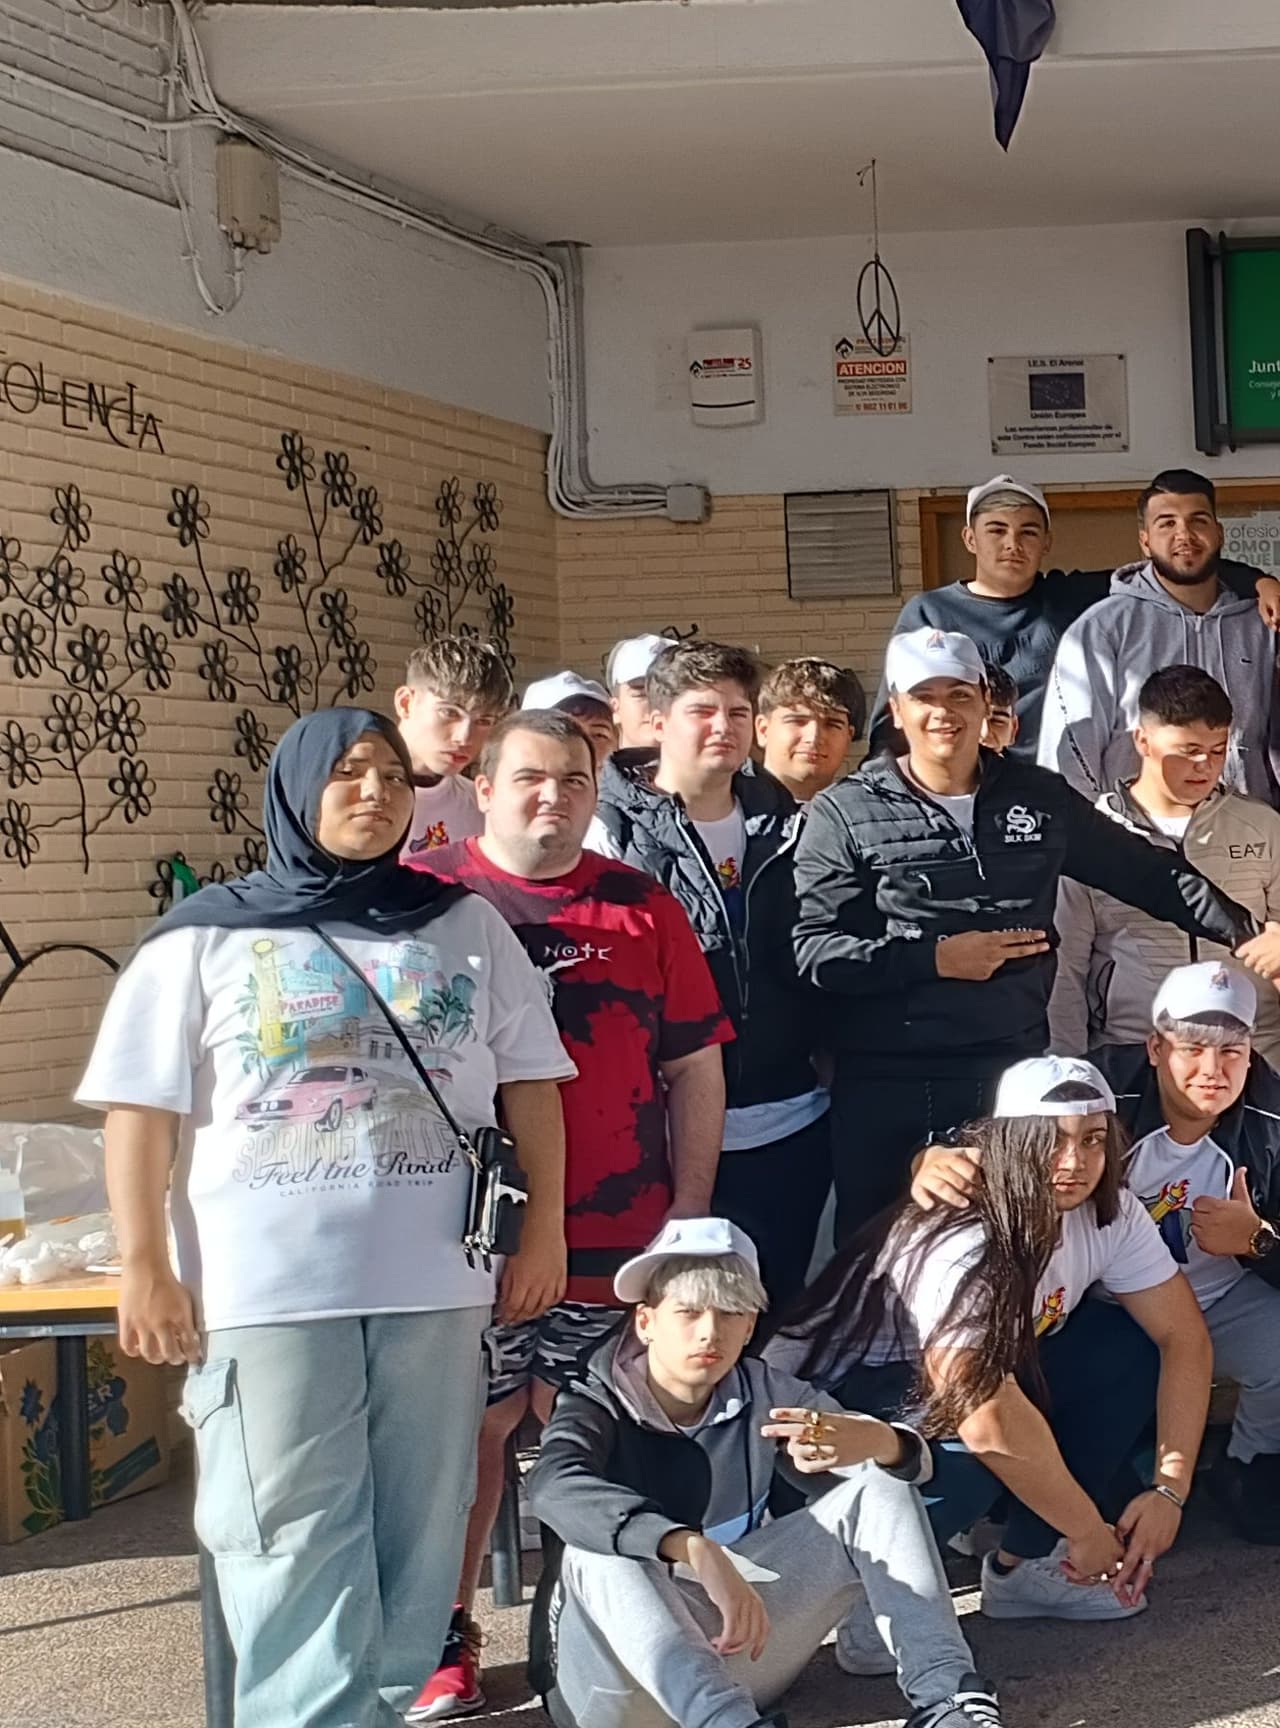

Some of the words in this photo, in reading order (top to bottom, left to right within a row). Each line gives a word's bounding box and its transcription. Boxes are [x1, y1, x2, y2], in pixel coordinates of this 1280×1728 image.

[840, 362, 905, 375] ATENCION
[0, 361, 166, 455] OLENCIA
[1226, 540, 1272, 553] OMO
[1228, 842, 1266, 859] EA7
[367, 1108, 461, 1168] VALLE
[249, 1157, 322, 1190] Feel
[407, 1179, 434, 1187] TRIP
